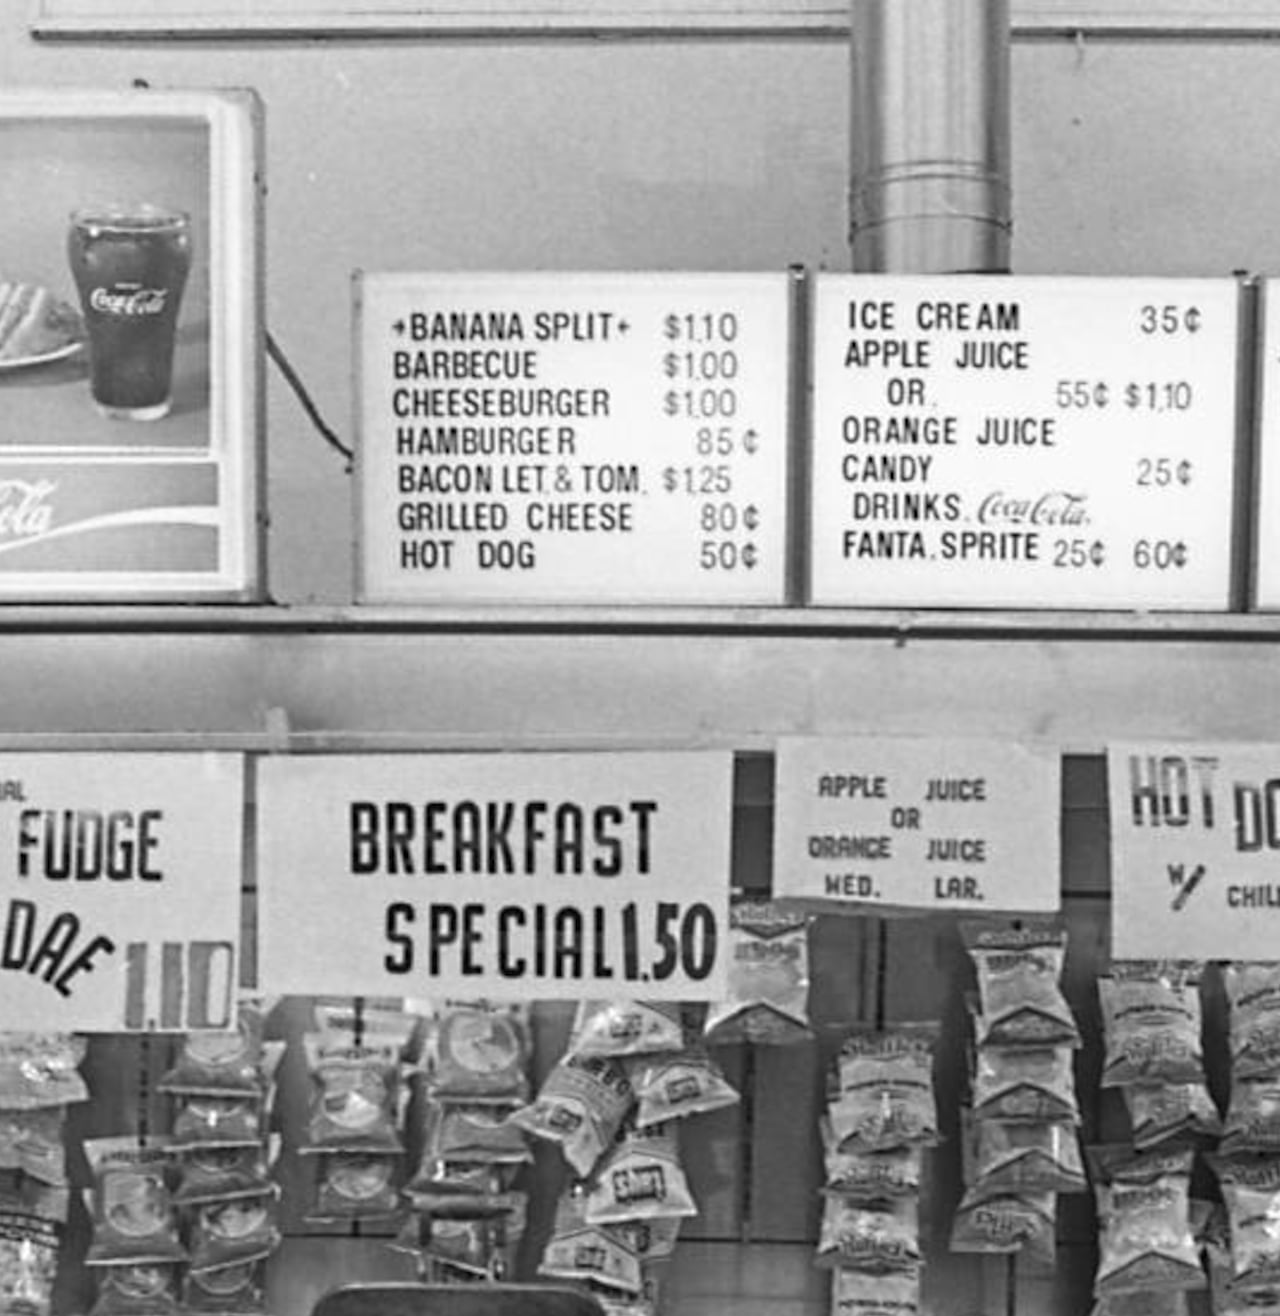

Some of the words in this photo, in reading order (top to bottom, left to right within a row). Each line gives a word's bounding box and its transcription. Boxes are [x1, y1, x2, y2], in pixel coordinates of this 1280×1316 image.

[410, 312, 524, 342] BANANA
[534, 312, 613, 342] SPLIT
[664, 313, 737, 344] $1.10
[849, 301, 895, 330] ICE
[917, 303, 1020, 330] CREAM
[394, 351, 538, 379] BARBECUE
[663, 351, 737, 381] $1.00
[845, 340, 930, 368] APPLE
[956, 341, 1029, 369] JUICE
[393, 389, 610, 417] CHEESEBURGER
[663, 389, 737, 419] $1.00
[1057, 381, 1109, 408] 55¢
[1124, 381, 1191, 412] $1.10
[396, 427, 575, 455] HAMBURGER
[842, 416, 957, 444] ORANGE
[977, 418, 1056, 445] JUICE
[399, 465, 493, 493] BACON
[555, 466, 573, 493] &
[842, 455, 933, 482] CANDY
[398, 503, 508, 531] GRILLED
[527, 503, 632, 531] CHEESE
[401, 541, 454, 569] HOT
[478, 541, 536, 569] DOG
[1054, 539, 1105, 568] 25¢
[819, 776, 888, 798] APPLE
[926, 779, 986, 801] JUICE
[1130, 756, 1219, 828] HOT
[891, 807, 920, 828] OR
[19, 809, 163, 882] FUDGE
[350, 801, 658, 876] BREAKFAST
[808, 836, 891, 858] ORANGE
[926, 840, 986, 862] JUICE
[935, 877, 984, 900] LAR.
[385, 902, 613, 979] SPECIAL
[621, 902, 716, 982] 1.50
[124, 941, 233, 1030] 1.10
